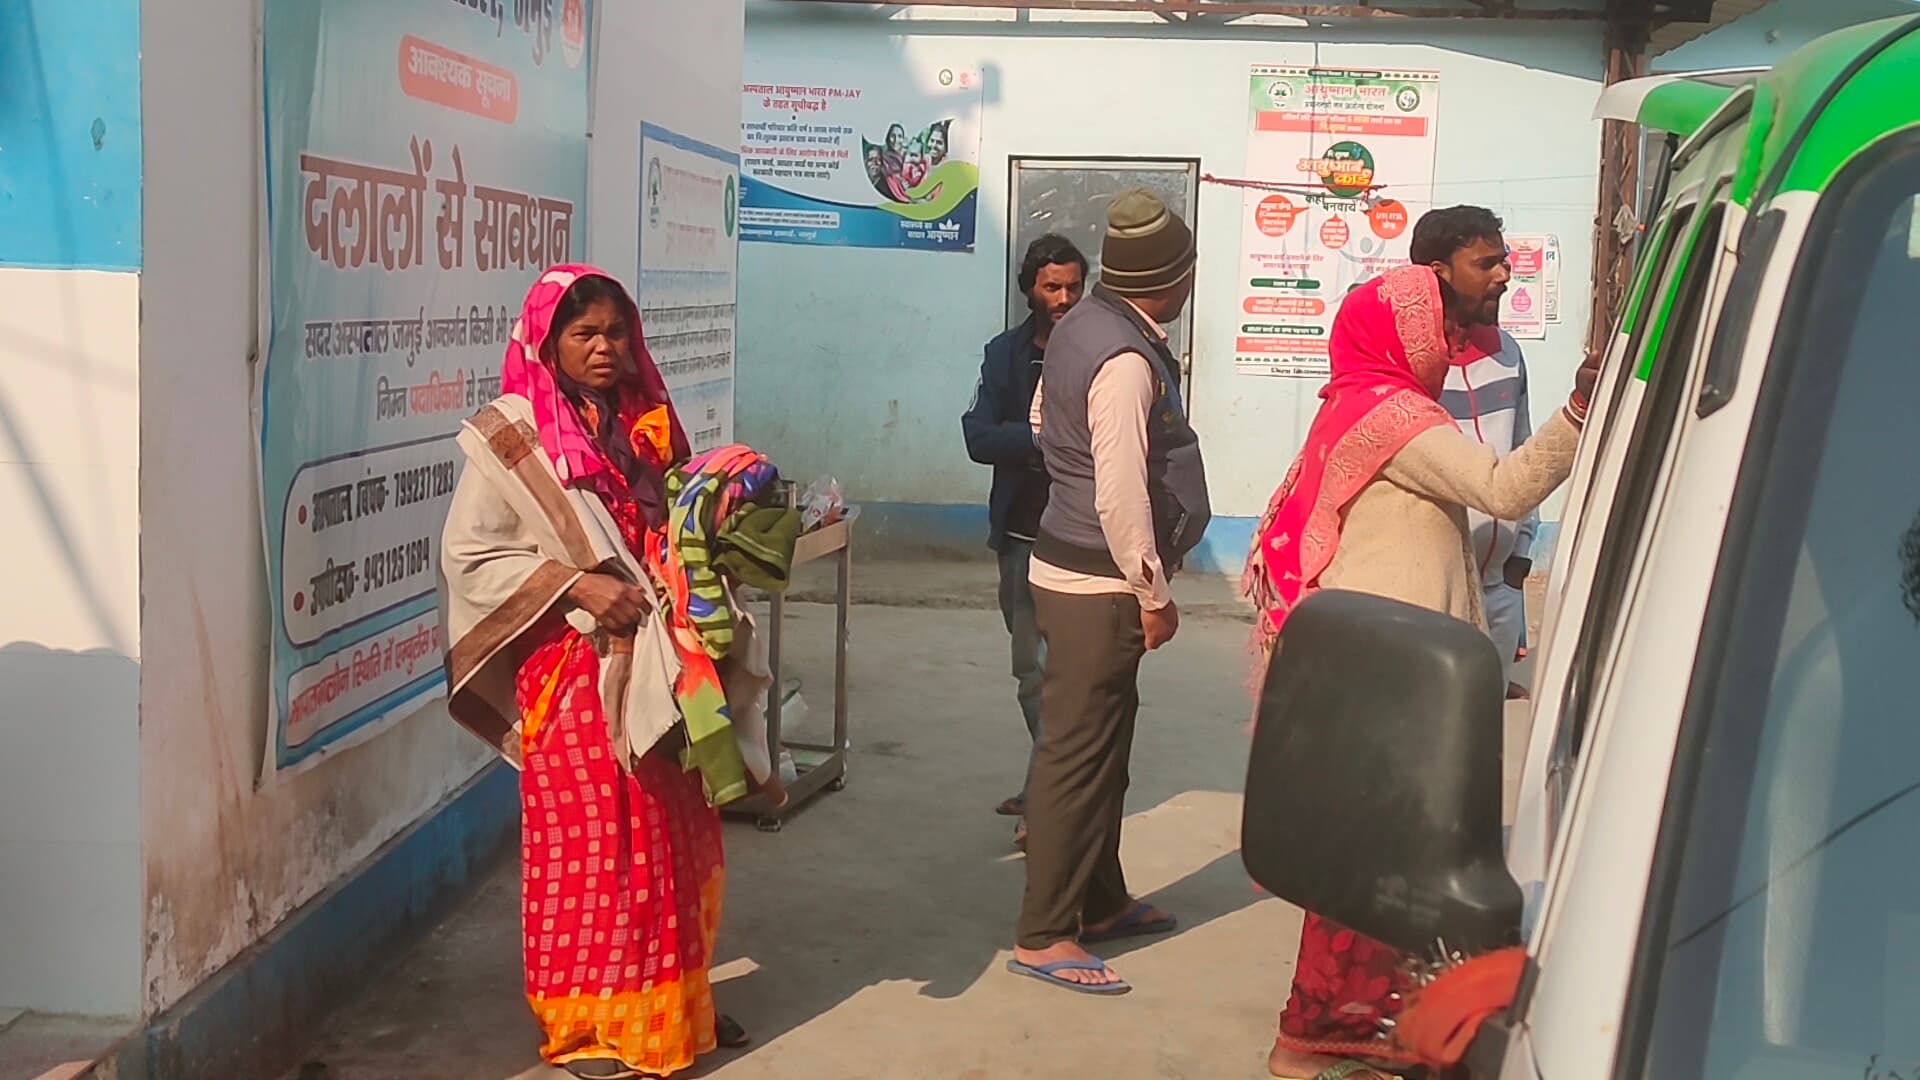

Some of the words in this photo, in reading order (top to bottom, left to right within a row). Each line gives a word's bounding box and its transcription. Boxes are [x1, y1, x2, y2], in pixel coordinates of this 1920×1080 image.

[475, 67, 511, 108] सूचना
[776, 86, 807, 98] आयुष्मान
[809, 87, 826, 97] भारत
[828, 88, 861, 98] PM-JAY
[1304, 85, 1353, 99] आयुष्मान
[1359, 86, 1387, 97] भारत
[763, 97, 771, 108] के
[821, 98, 827, 111] है
[1297, 158, 1364, 177] आयुष्मान
[1334, 169, 1372, 185] कार्ड
[301, 133, 432, 270] दलालों
[436, 144, 466, 270] से
[474, 185, 573, 272] सावधान
[926, 230, 960, 243] आयुष्मान
[305, 321, 332, 359] सदर
[333, 320, 389, 356] अस्पताल
[392, 306, 425, 368] जमुई
[426, 306, 467, 349] अन्तर्गत
[469, 306, 494, 345] किसी
[496, 306, 508, 343] भी
[466, 369, 476, 407] से
[353, 642, 381, 689] स्थिति
[383, 636, 395, 672] में
